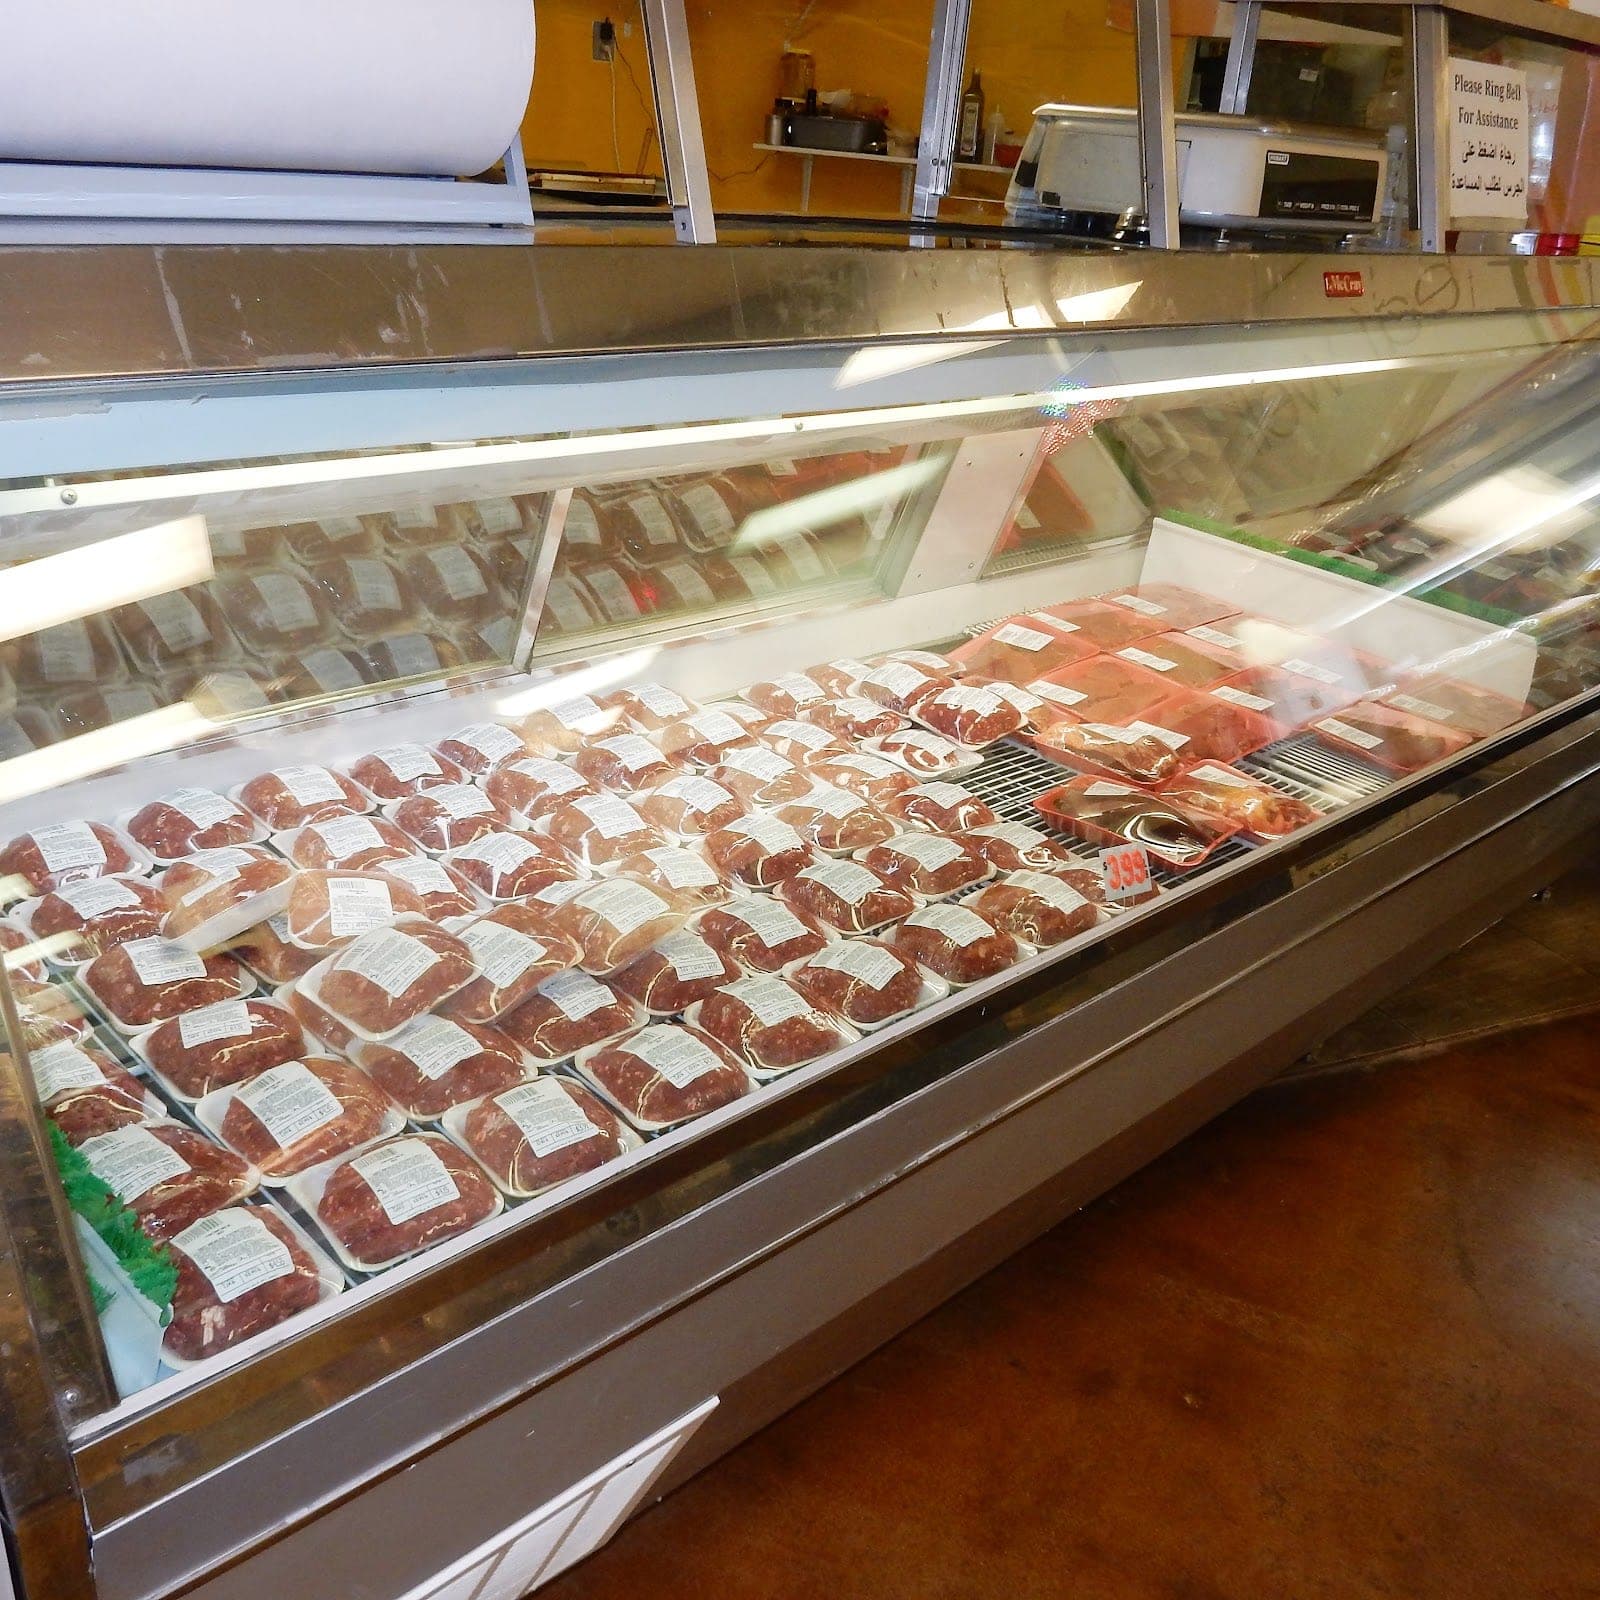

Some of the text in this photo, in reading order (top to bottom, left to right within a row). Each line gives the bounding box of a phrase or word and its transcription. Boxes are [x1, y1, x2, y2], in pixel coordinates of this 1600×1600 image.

[1454, 74, 1521, 103] Please Ring Bell
[1458, 107, 1519, 130] For Assistance
